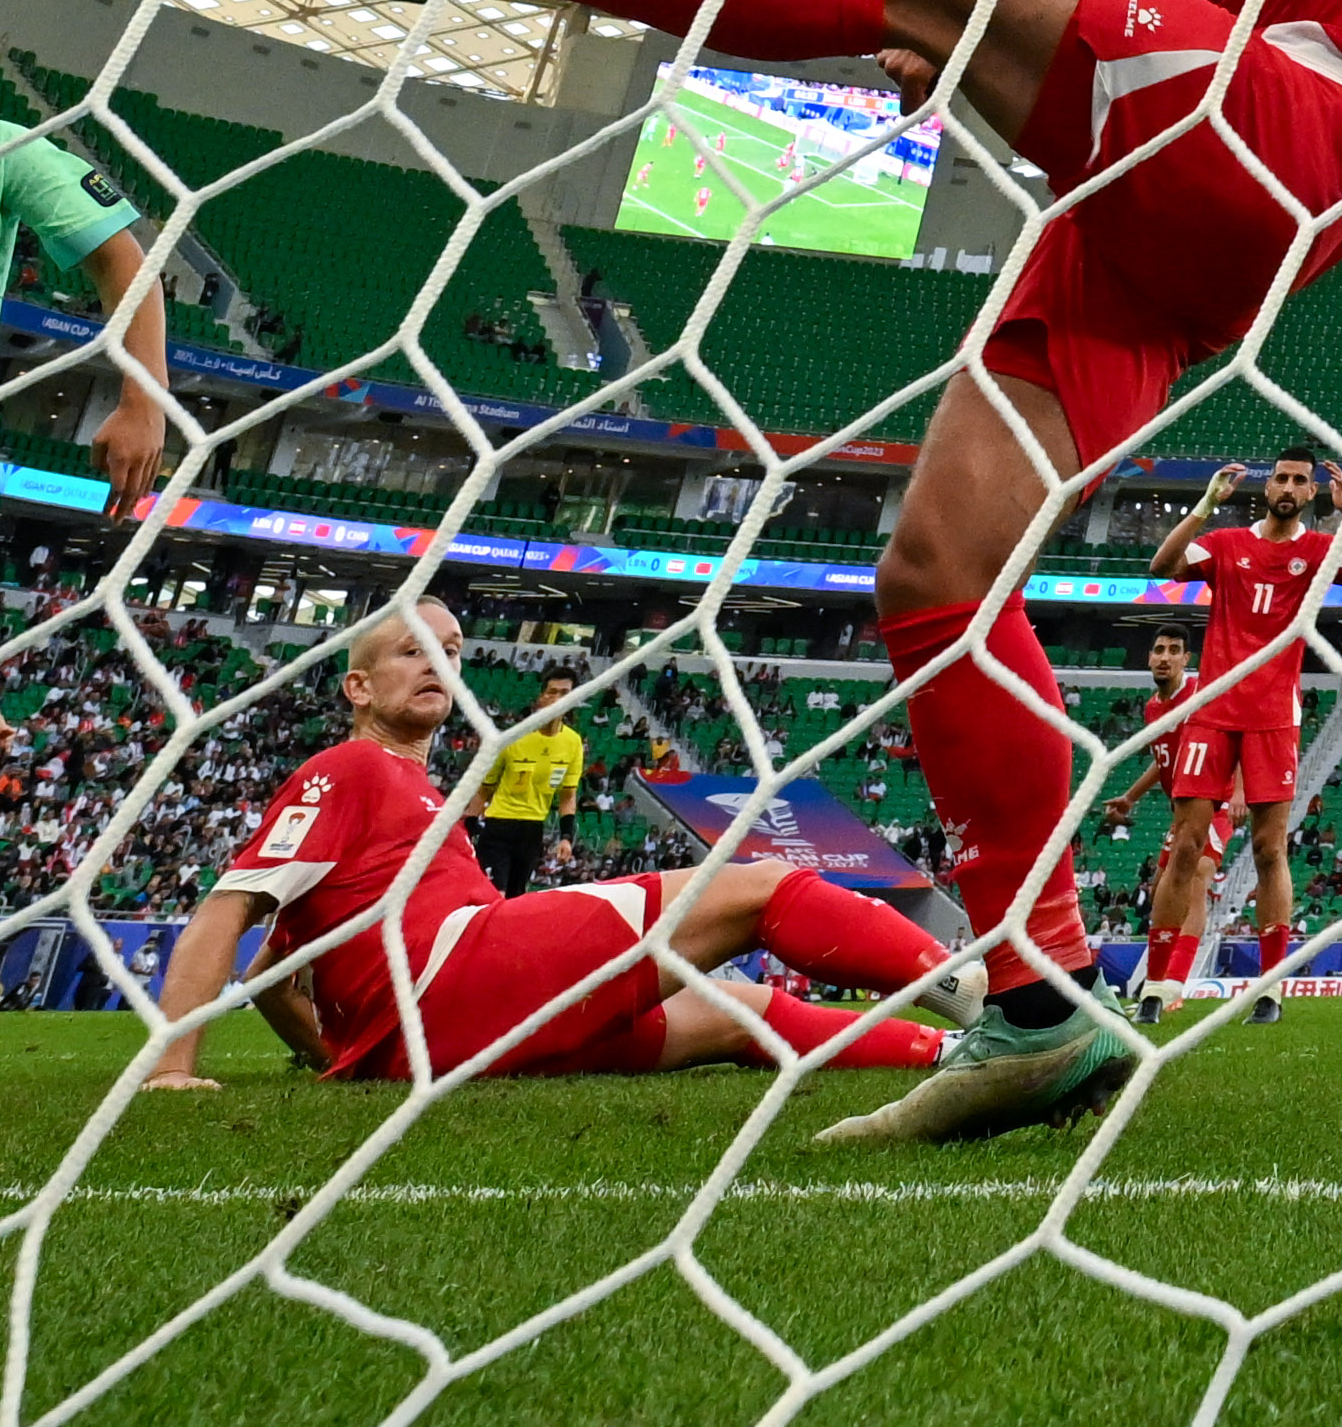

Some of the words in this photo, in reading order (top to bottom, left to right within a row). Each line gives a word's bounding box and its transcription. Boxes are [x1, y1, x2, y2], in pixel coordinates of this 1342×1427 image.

[1107, 583, 1117, 597] 0
[1251, 582, 1275, 614] 11
[1183, 742, 1208, 776] 11
[821, 853, 870, 863] CUP
